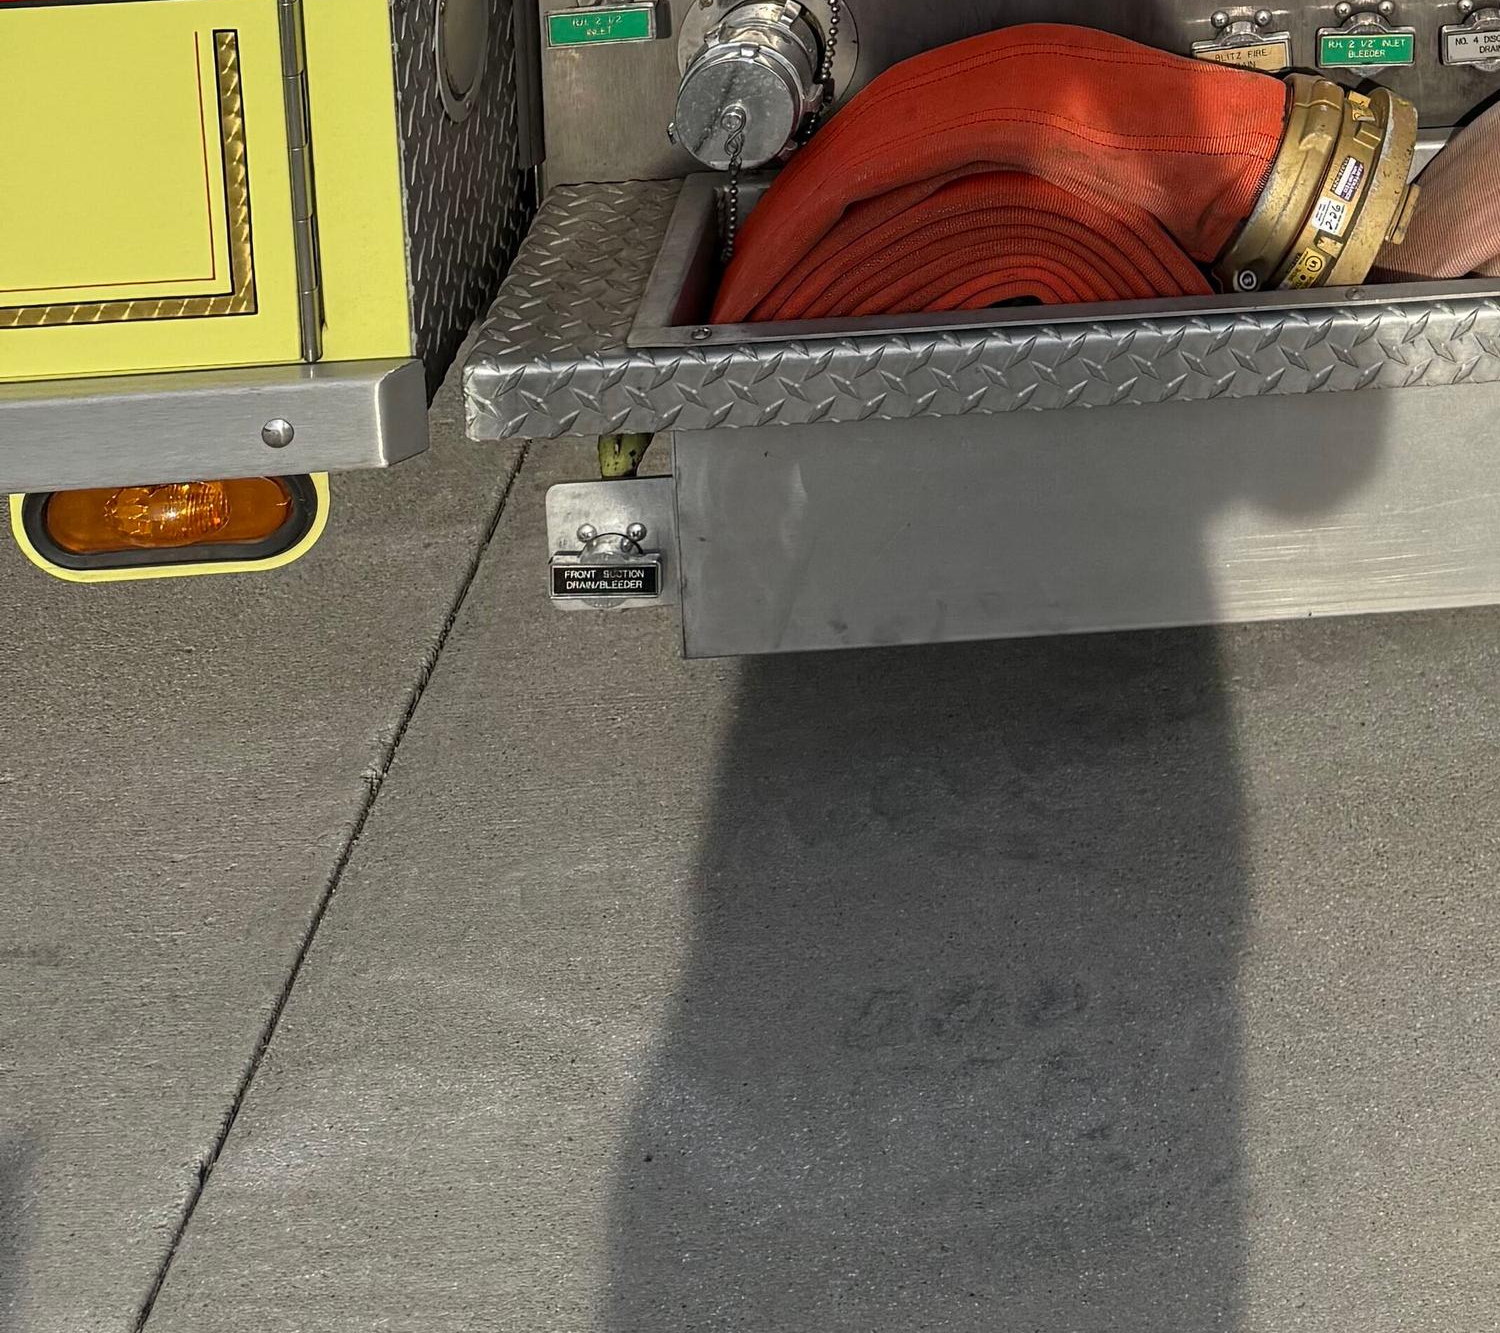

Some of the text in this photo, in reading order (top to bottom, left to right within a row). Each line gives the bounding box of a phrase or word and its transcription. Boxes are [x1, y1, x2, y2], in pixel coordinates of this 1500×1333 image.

[1381, 38, 1405, 47] INLET
[1455, 36, 1469, 46] NO.
[1214, 48, 1267, 62] BLITZ FIRE
[1348, 49, 1386, 58] BLEEDER
[564, 569, 645, 579] FRONT SUCTION
[566, 580, 643, 589] DRAIN/BLEEDER
